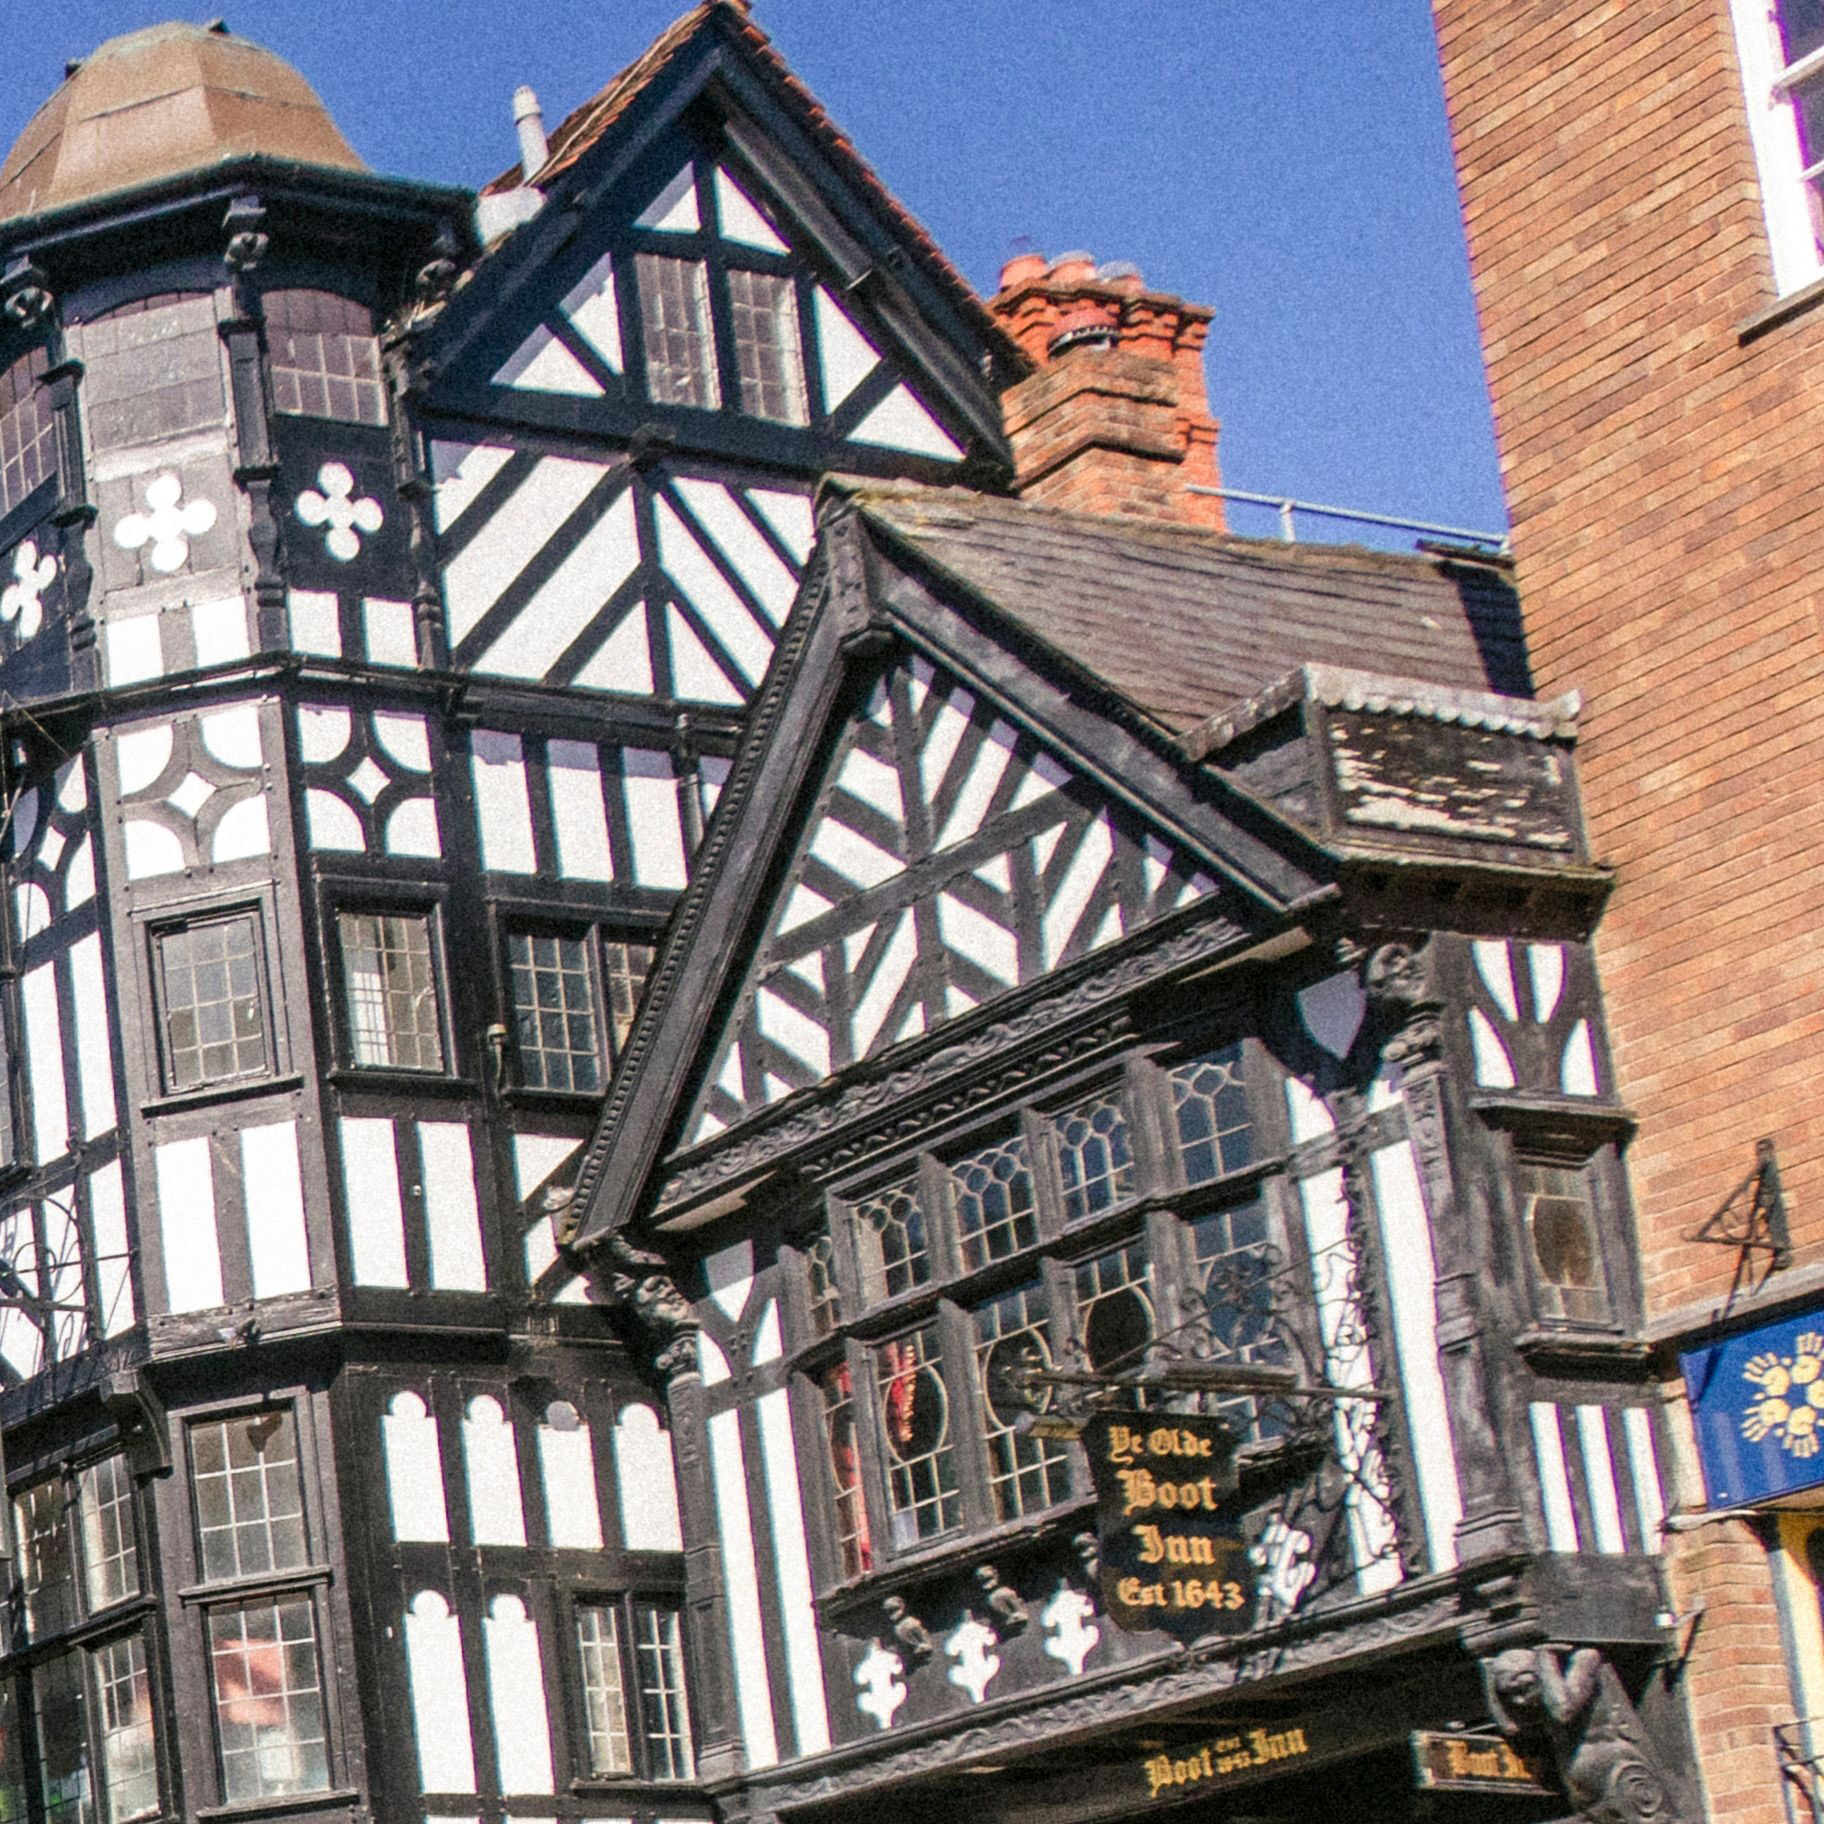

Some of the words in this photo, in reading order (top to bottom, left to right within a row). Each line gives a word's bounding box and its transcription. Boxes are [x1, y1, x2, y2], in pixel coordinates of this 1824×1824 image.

[1108, 1425, 1144, 1464] Ye
[1148, 1427, 1213, 1457] Olde
[1115, 1468, 1218, 1516] Boot
[1131, 1524, 1216, 1565] Inn
[1117, 1576, 1168, 1607] Est
[1172, 1579, 1245, 1611] 1643
[1143, 1748, 1213, 1798] Boot
[1249, 1727, 1309, 1766] Inn
